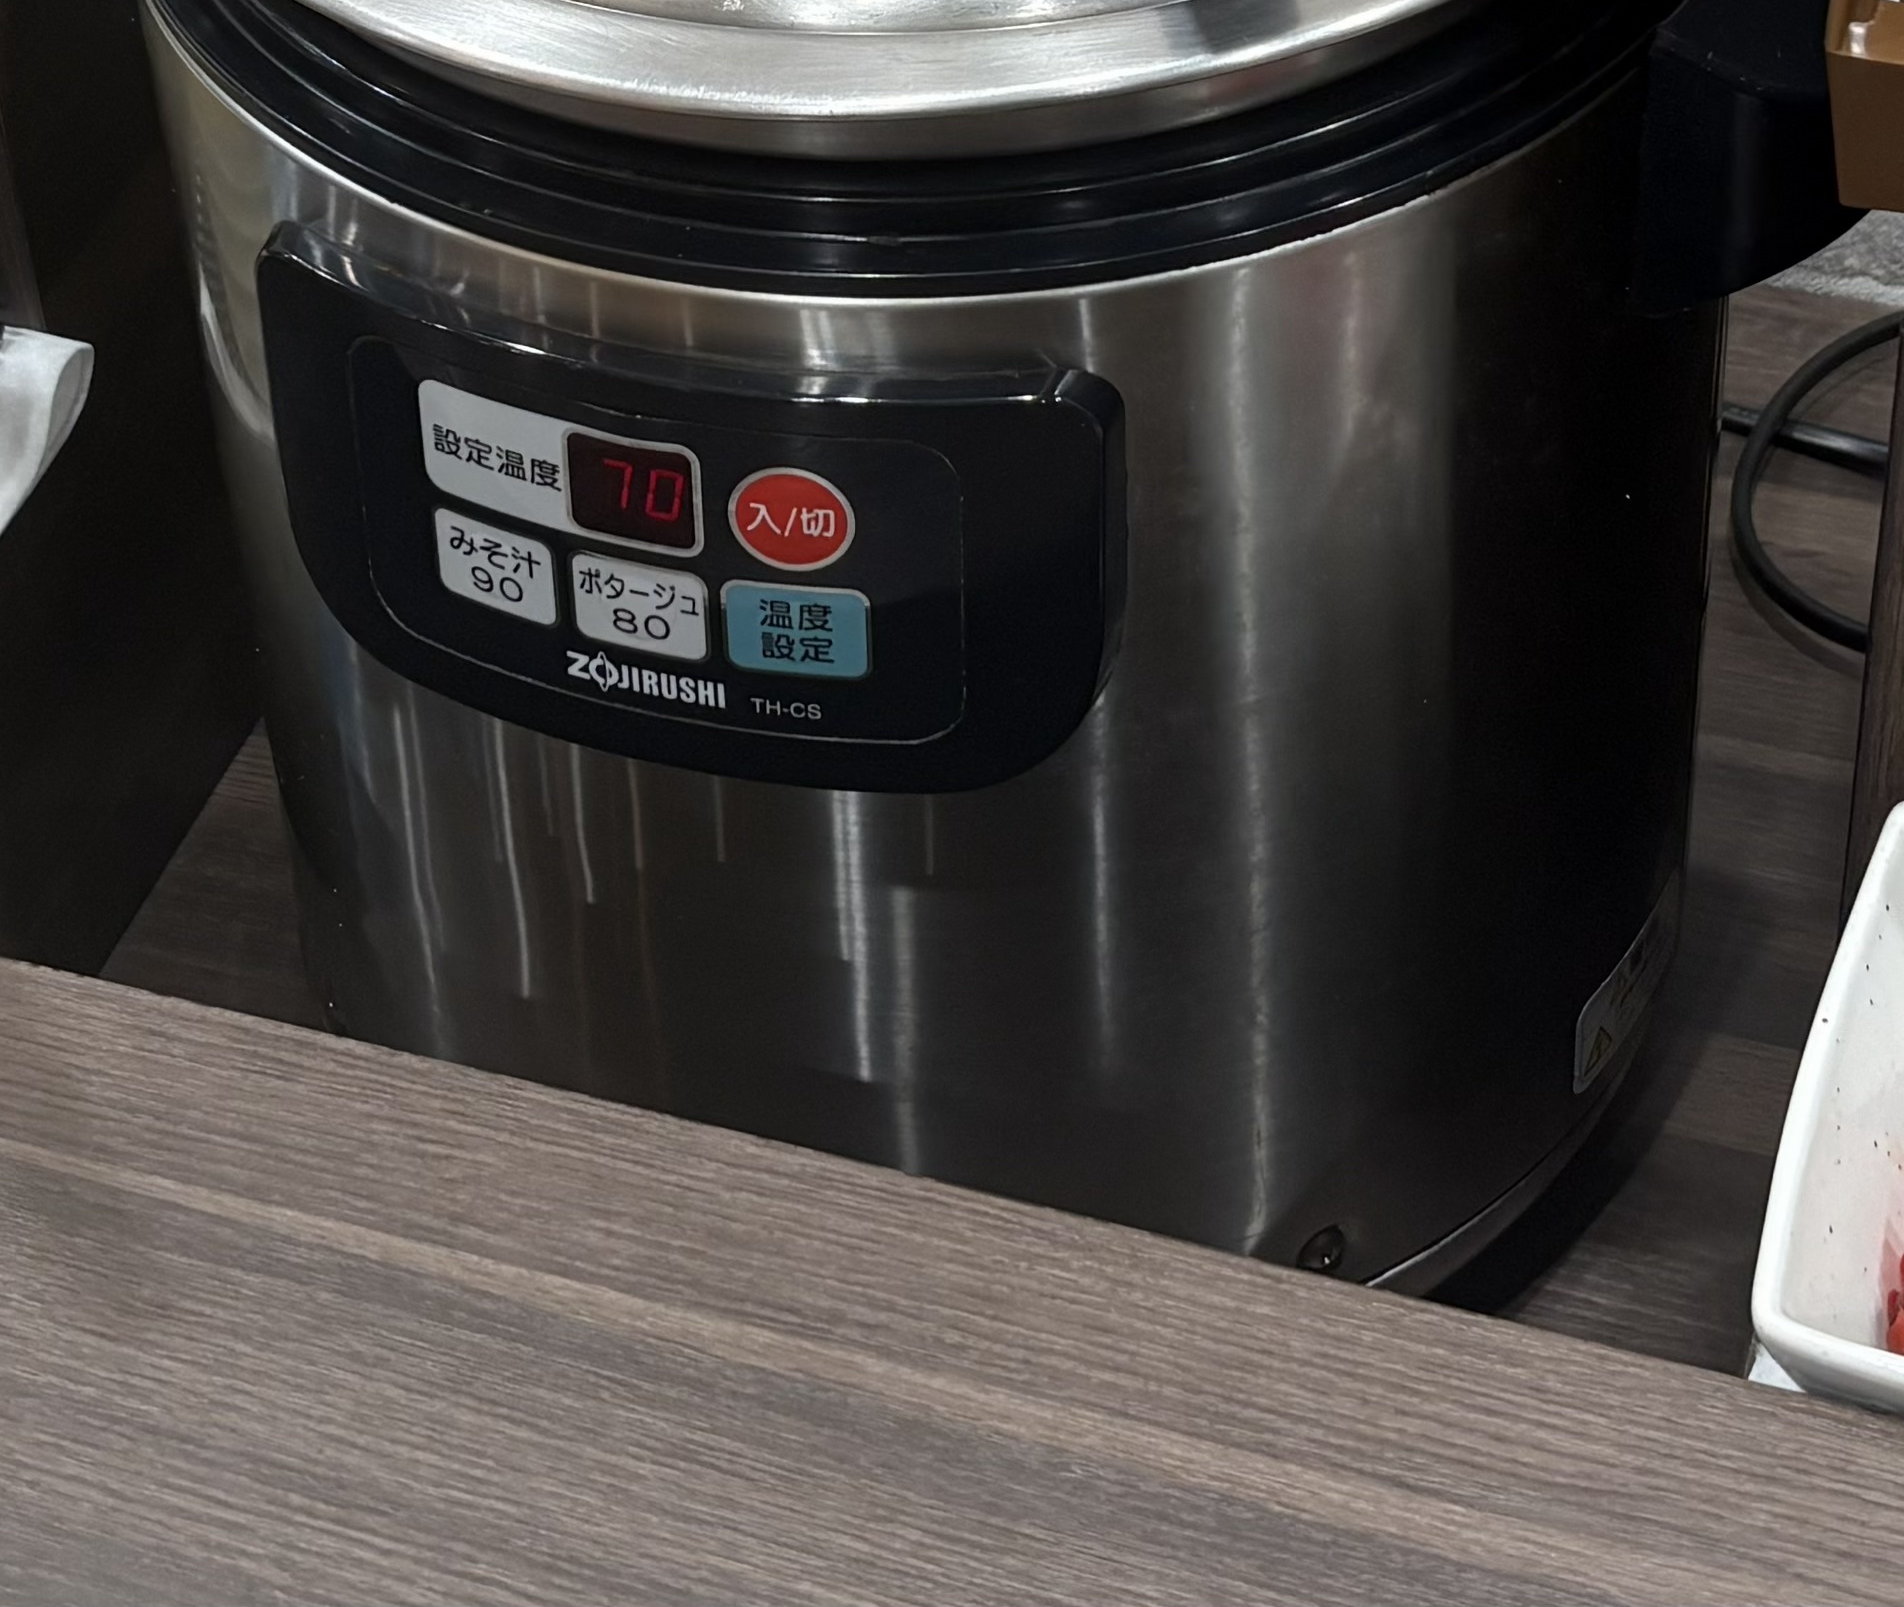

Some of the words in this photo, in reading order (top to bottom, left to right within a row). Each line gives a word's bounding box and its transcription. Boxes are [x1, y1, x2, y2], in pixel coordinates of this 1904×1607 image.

[432, 424, 561, 493] 設定温度
[603, 457, 684, 522] 70
[747, 502, 835, 539] 入/切
[448, 525, 540, 578] みそ汁
[471, 565, 524, 603] 90
[578, 566, 700, 617] ポタージュ
[612, 610, 671, 641] 80
[759, 600, 833, 631] 温度
[761, 633, 835, 665] 設定
[567, 650, 726, 709] ZOJIRUSHI
[750, 698, 822, 720] TH-CS
